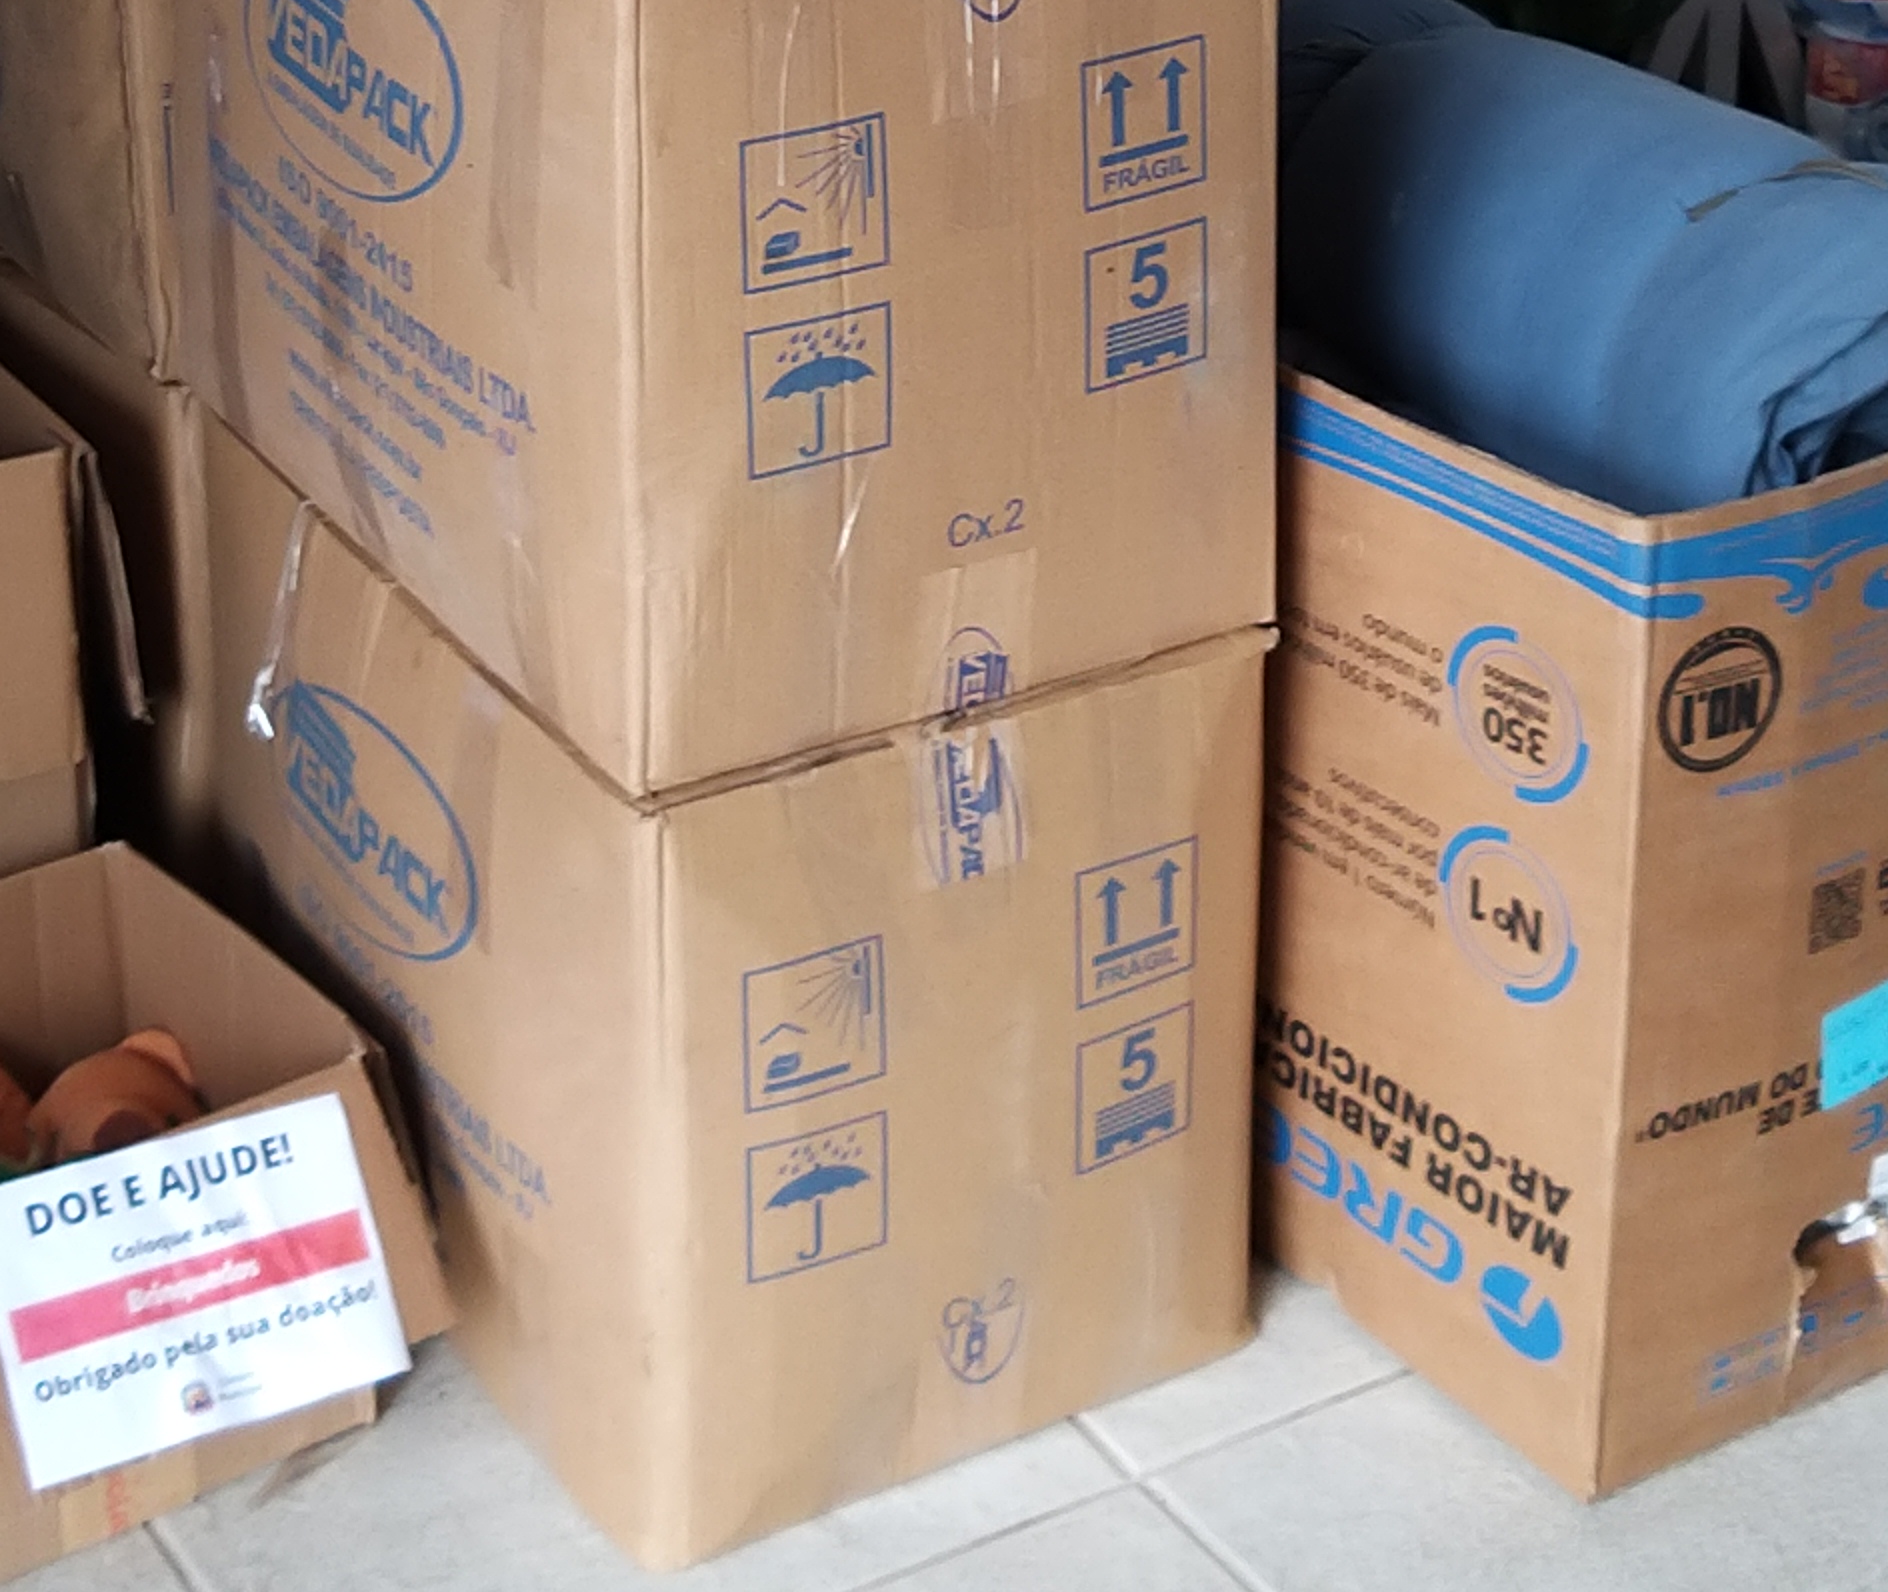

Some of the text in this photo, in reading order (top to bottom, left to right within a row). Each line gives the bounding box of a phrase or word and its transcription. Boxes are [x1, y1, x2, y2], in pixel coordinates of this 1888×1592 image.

[1101, 153, 1192, 194] FRÁGIL
[1129, 241, 1170, 310] 5
[1361, 612, 1430, 658] mundo
[1372, 675, 1398, 703] de
[1482, 662, 1552, 706] usuários
[1482, 682, 1550, 725] milhões
[1400, 689, 1441, 729] Mais
[1482, 706, 1549, 767] 350
[1366, 874, 1436, 931] Número
[1119, 1026, 1157, 1093] 5
[1769, 1061, 1810, 1100] DO
[1757, 1101, 1796, 1136] DE
[24, 1131, 294, 1237] DOE E AJUDE!
[1425, 1151, 1572, 1271] MAIOR
[111, 1229, 193, 1263] Coloque
[35, 1279, 379, 1404] Obrigado pela sua doação!
